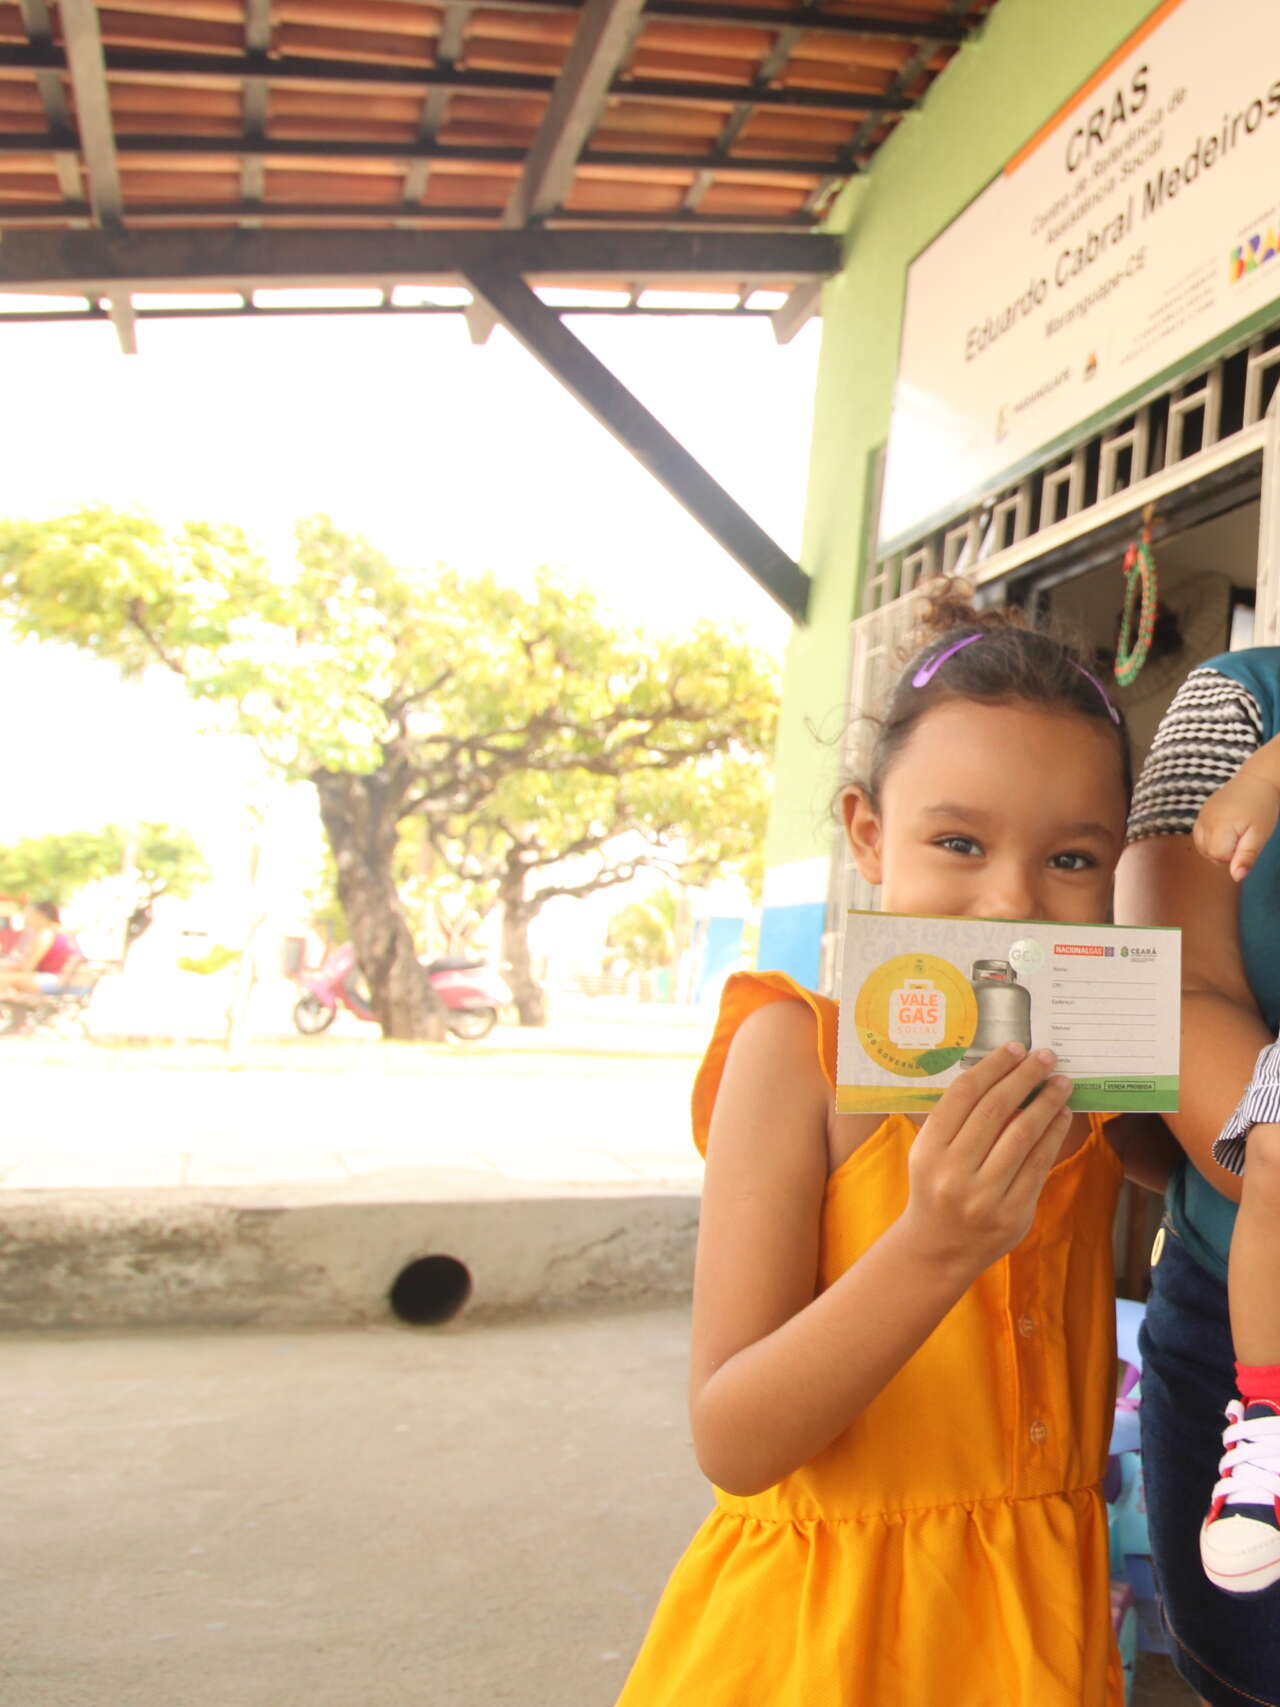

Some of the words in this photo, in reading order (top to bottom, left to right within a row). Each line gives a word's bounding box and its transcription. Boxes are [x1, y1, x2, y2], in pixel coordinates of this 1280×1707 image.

[1064, 65, 1150, 173] CRAS
[964, 276, 1049, 364] Eduardo
[1054, 193, 1136, 288] Cabral
[899, 993, 939, 1008] VALE
[897, 1007, 940, 1025] GAS
[896, 1025, 938, 1035] SOCIAL
